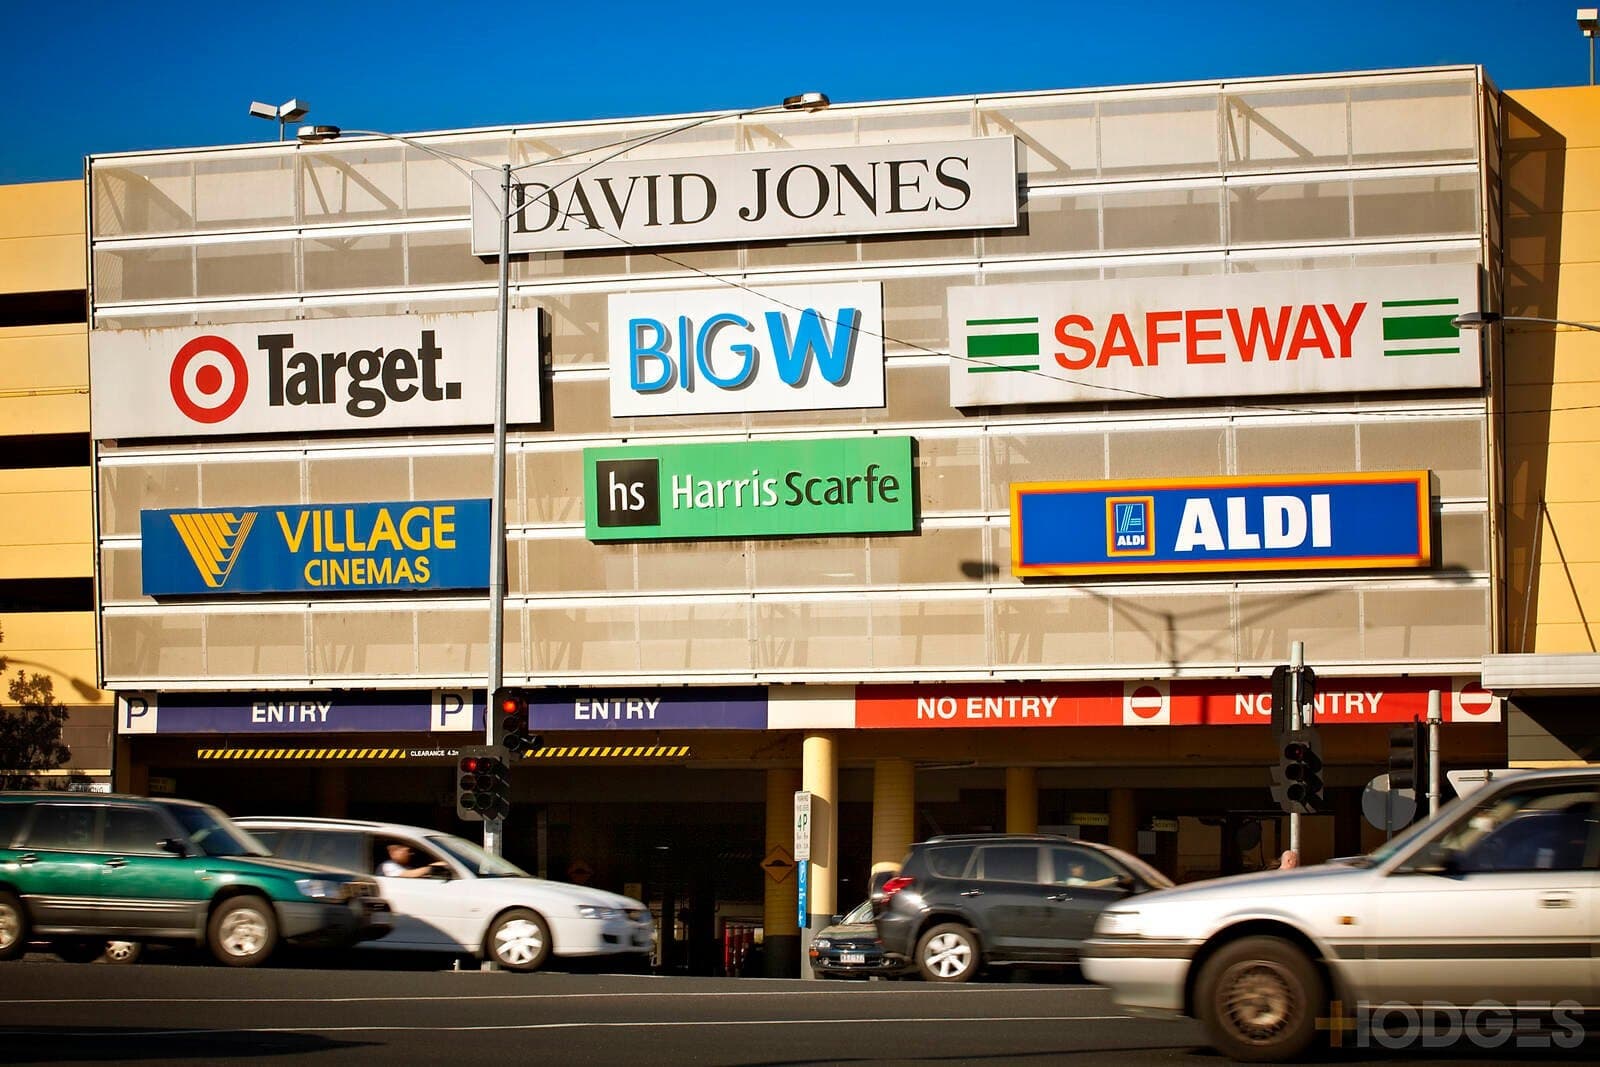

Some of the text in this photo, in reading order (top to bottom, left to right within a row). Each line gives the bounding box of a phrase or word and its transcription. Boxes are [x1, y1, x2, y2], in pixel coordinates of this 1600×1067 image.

[512, 156, 972, 234] DAVID JONES
[1053, 302, 1368, 371] SAFEWAY
[608, 470, 645, 512] hs
[671, 463, 900, 510] Harris Scarfe
[276, 506, 456, 553] VILLAGE
[1174, 493, 1333, 553] ALDI
[1116, 534, 1146, 547] ALDI
[303, 556, 431, 587] CINEMAS
[126, 697, 149, 729] P
[251, 701, 333, 723] ENTRY
[440, 693, 464, 727] P
[574, 697, 661, 721] ENTRY
[916, 696, 1059, 720] NO ENTRY
[1313, 692, 1384, 715] NTRY
